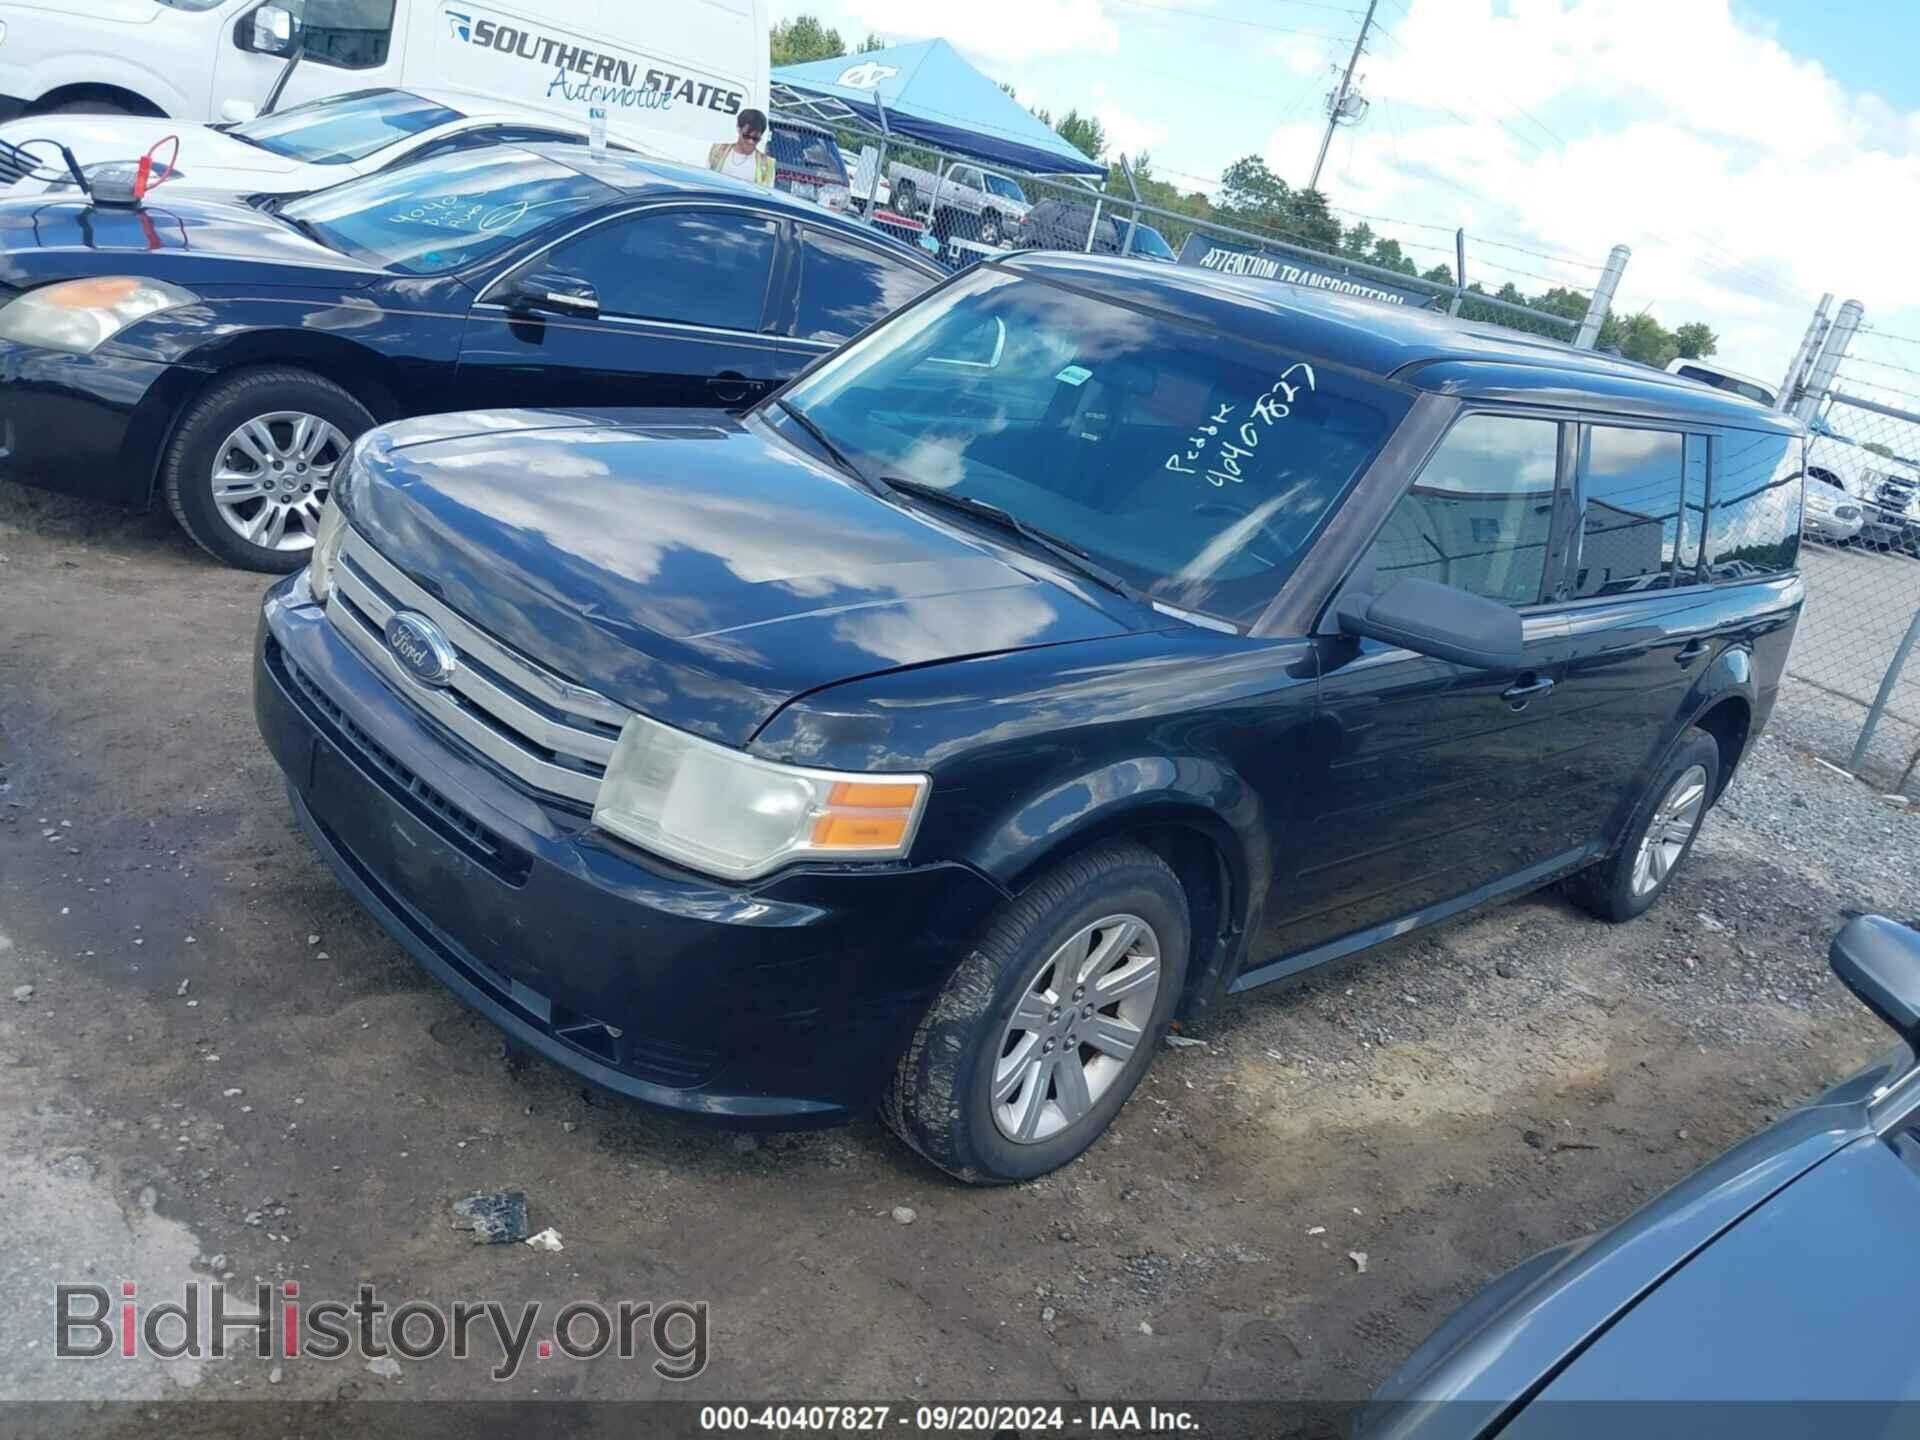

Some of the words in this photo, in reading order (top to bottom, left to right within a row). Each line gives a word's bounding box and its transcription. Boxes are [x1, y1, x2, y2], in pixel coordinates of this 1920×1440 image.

[472, 19, 637, 87] SOUTHERN
[646, 69, 743, 116] STATES
[547, 66, 672, 111] Automotive
[1200, 248, 1279, 280] ATTENTION
[1206, 362, 1316, 487] 40407827
[391, 624, 428, 667] Ford
